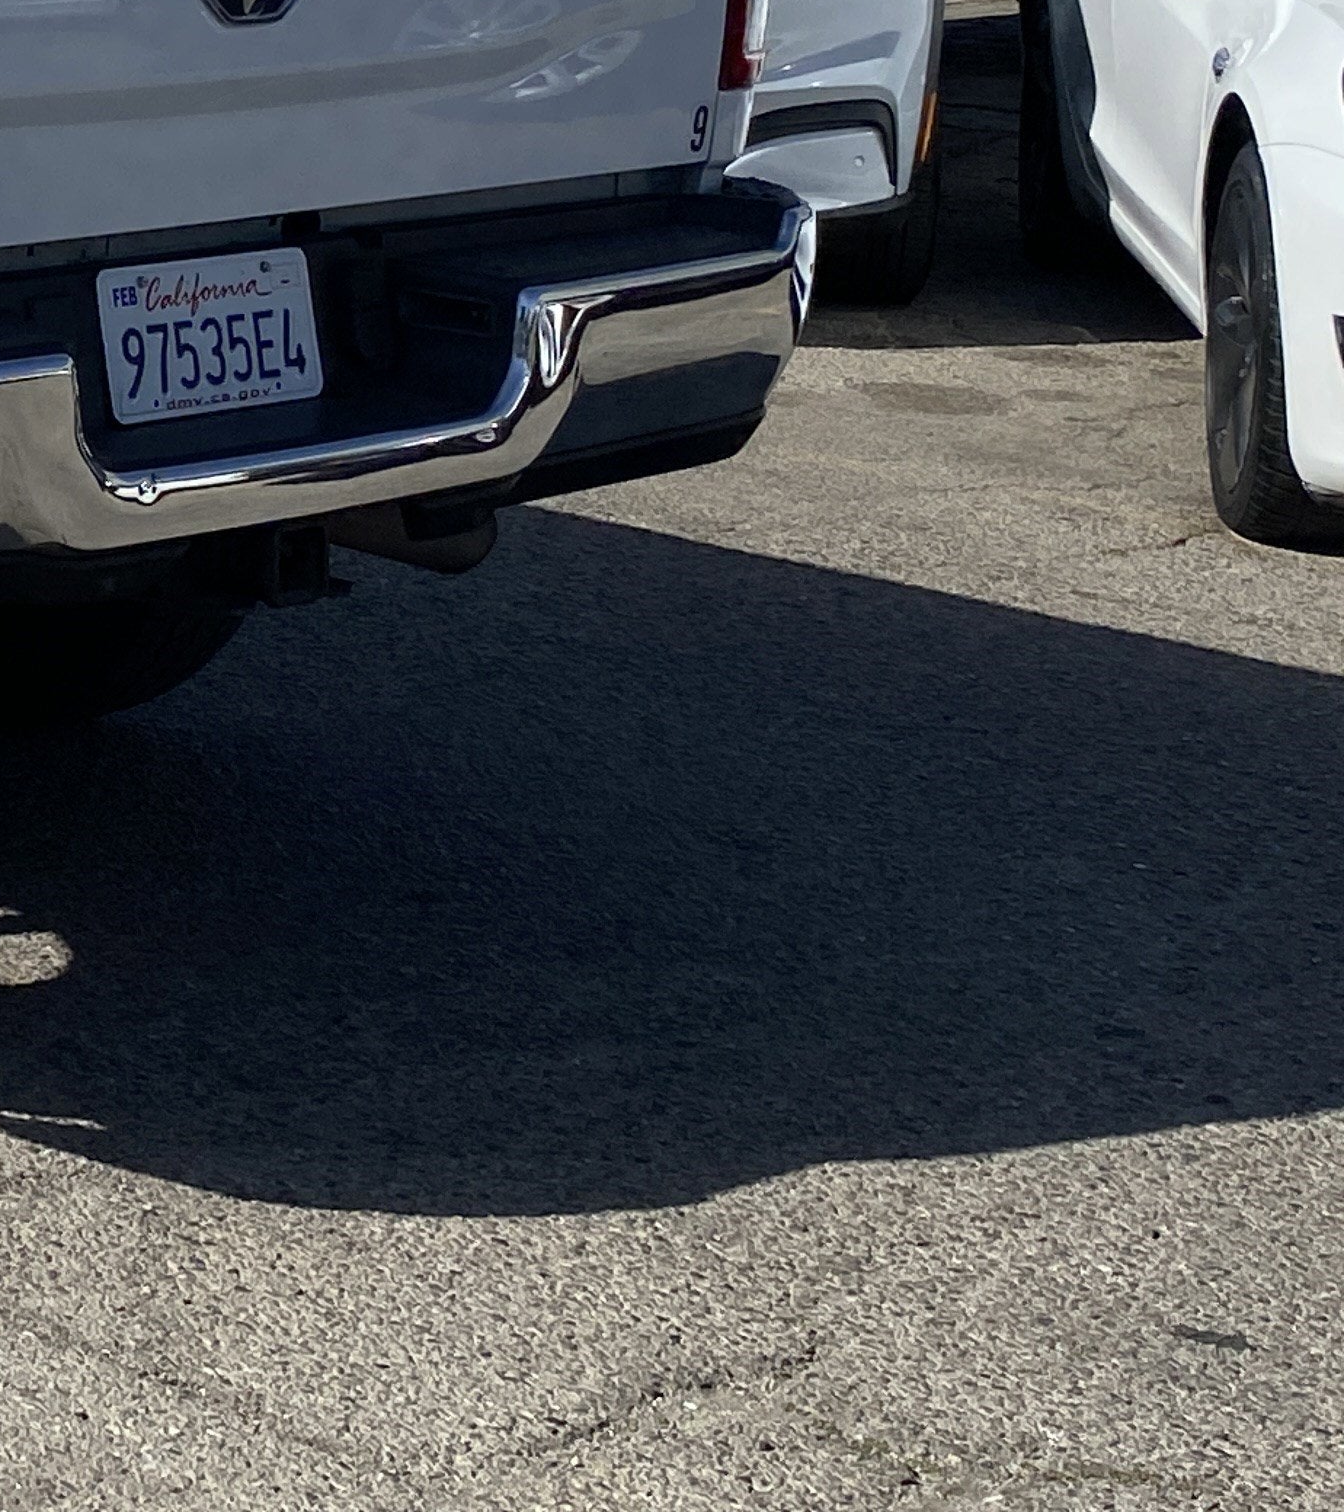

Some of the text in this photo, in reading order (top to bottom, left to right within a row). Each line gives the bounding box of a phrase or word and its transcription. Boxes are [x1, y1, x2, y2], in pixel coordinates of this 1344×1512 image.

[690, 105, 709, 152] 9
[111, 284, 138, 308] FEB
[145, 272, 272, 317] California
[120, 308, 308, 400] 97535E4
[165, 386, 273, 411] dmv.ca.gov
